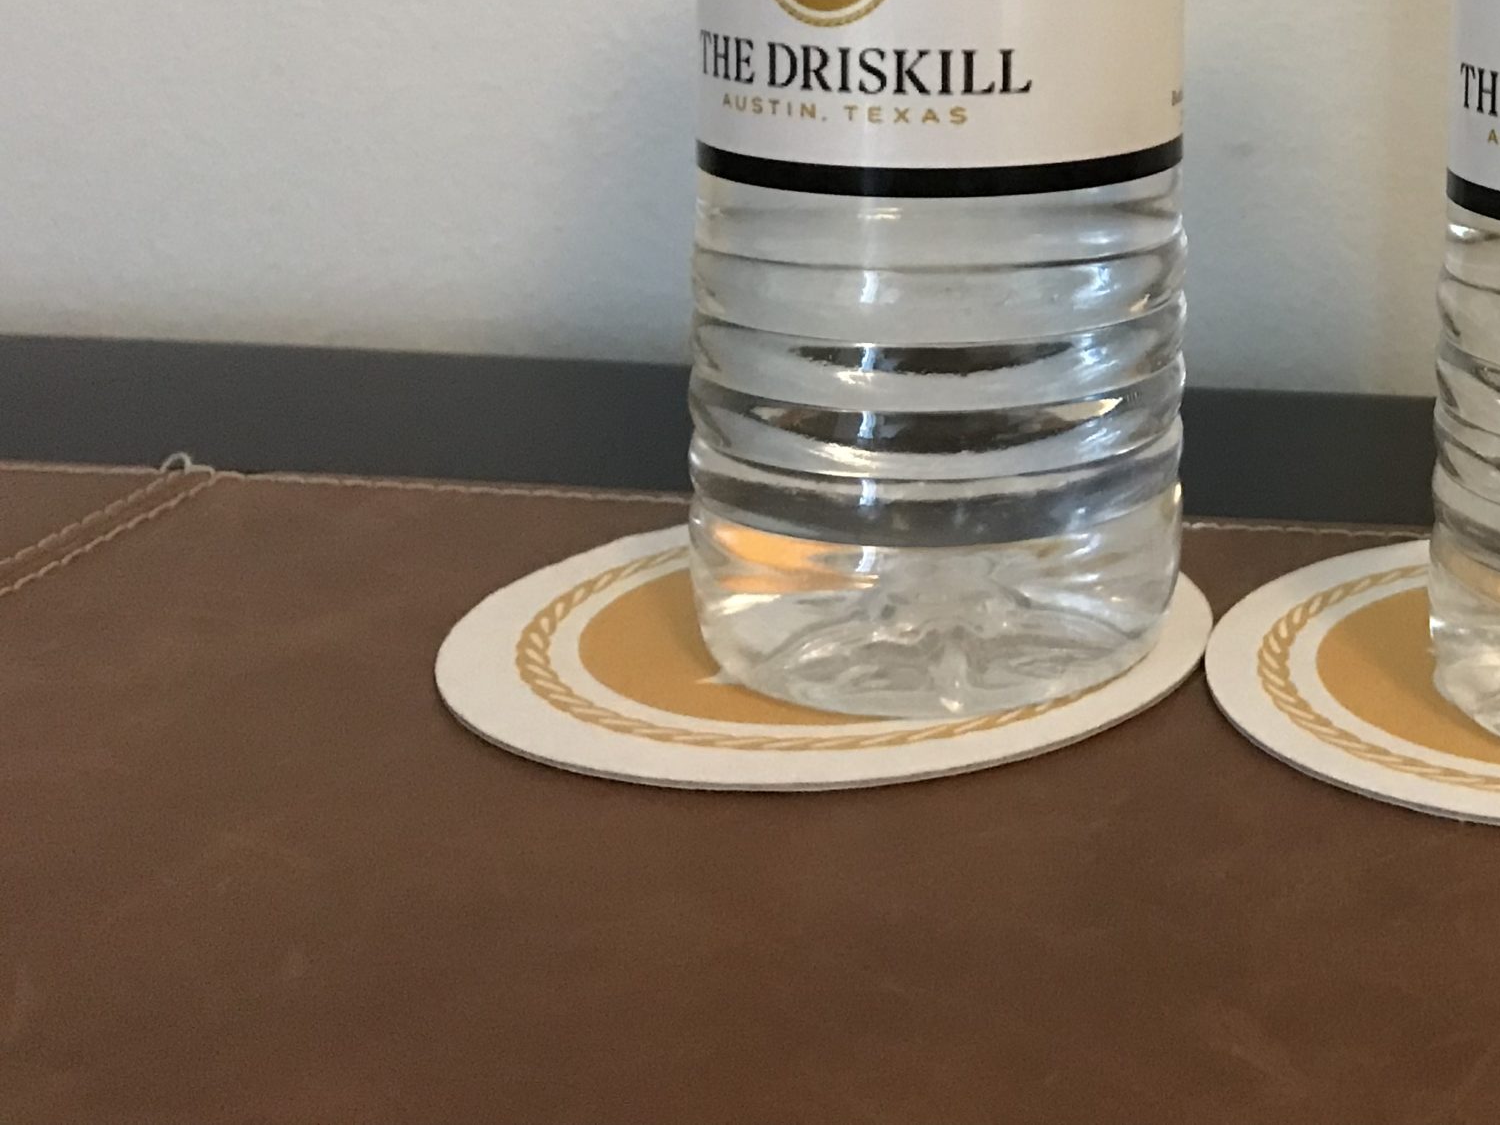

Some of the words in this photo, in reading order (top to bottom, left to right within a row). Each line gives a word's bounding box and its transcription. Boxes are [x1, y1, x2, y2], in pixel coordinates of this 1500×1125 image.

[700, 29, 756, 85] THE
[766, 41, 1033, 96] DRISKILL
[843, 105, 968, 125] TEXAS
